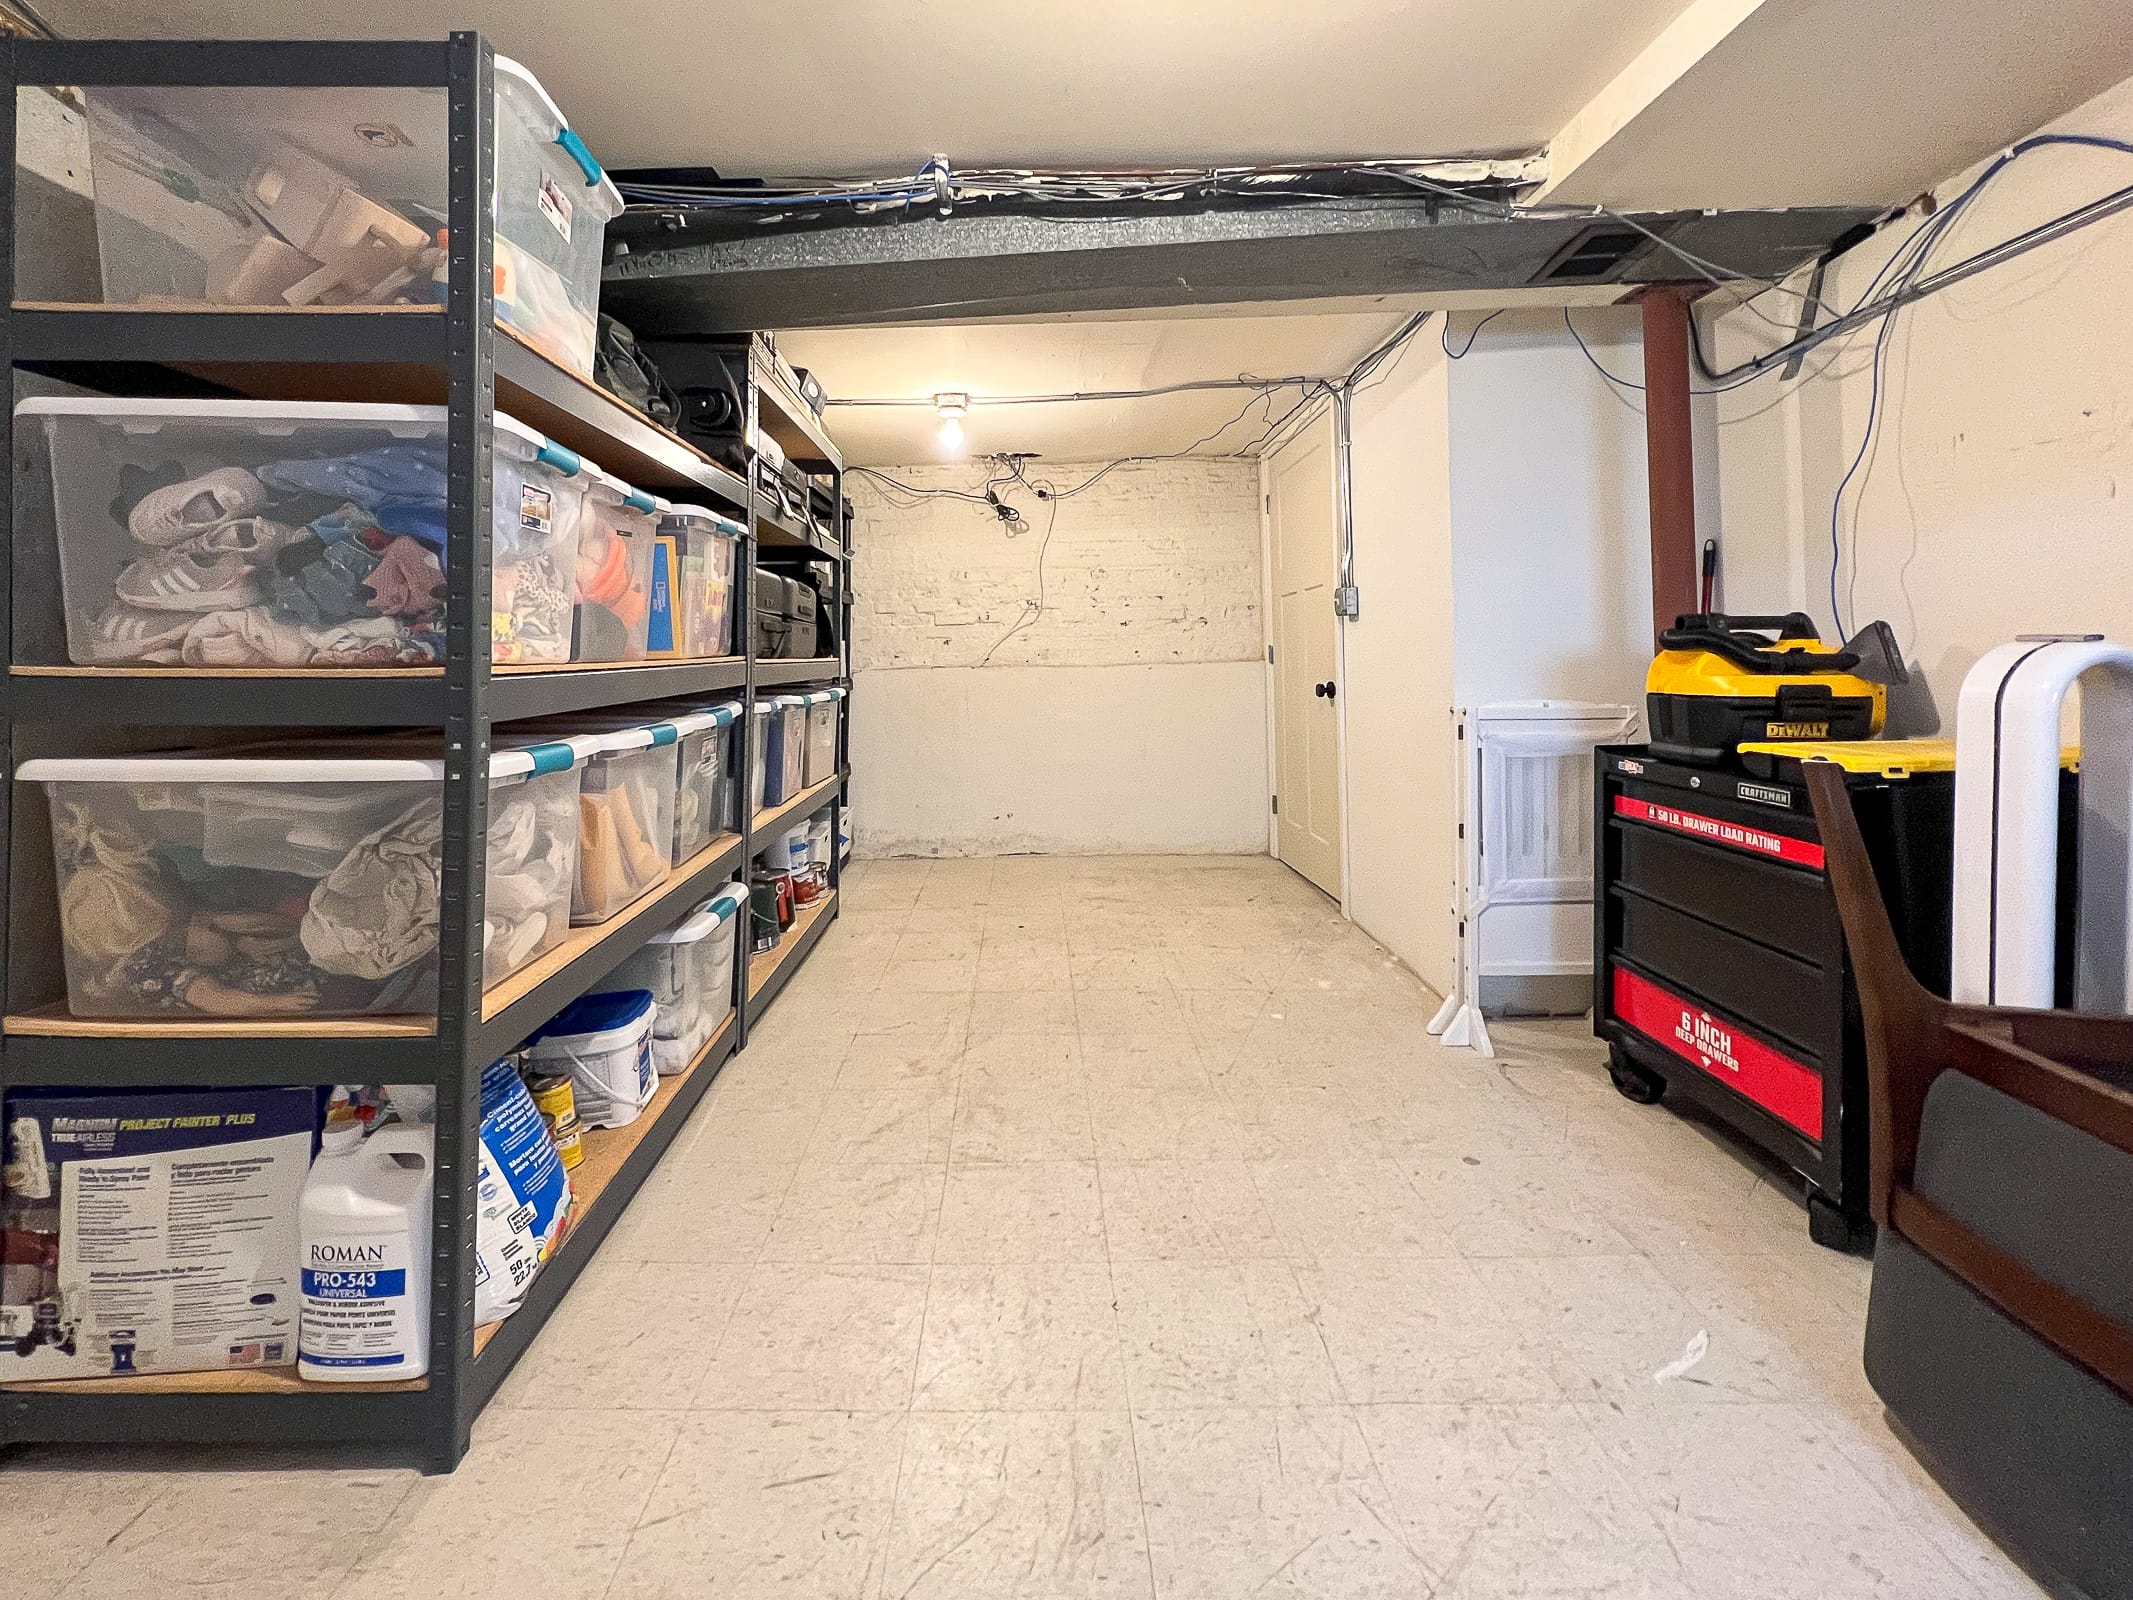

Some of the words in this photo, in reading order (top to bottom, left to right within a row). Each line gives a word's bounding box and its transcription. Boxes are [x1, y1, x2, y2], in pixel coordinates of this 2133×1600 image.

[1740, 786, 1788, 804] CRAFTSMAN
[1657, 809, 1667, 822] 50
[1669, 812, 1681, 826] LB.
[1682, 816, 1719, 836] DRAWER
[1720, 825, 1744, 842] LOAD
[1745, 831, 1781, 852] RATING
[1682, 1010, 1691, 1032] 6
[1695, 1017, 1731, 1056] INCH
[1675, 1025, 1695, 1045] DEEP
[1696, 1038, 1739, 1073] DRAWERS
[120, 1118, 171, 1131] PROJECT
[172, 1115, 220, 1129] PAINTER
[225, 1113, 256, 1126] PLUS
[311, 1244, 383, 1261] ROMAN
[510, 1259, 523, 1275] 50
[313, 1272, 377, 1288] PRO-543
[319, 1288, 368, 1298] UNIVERSAL
